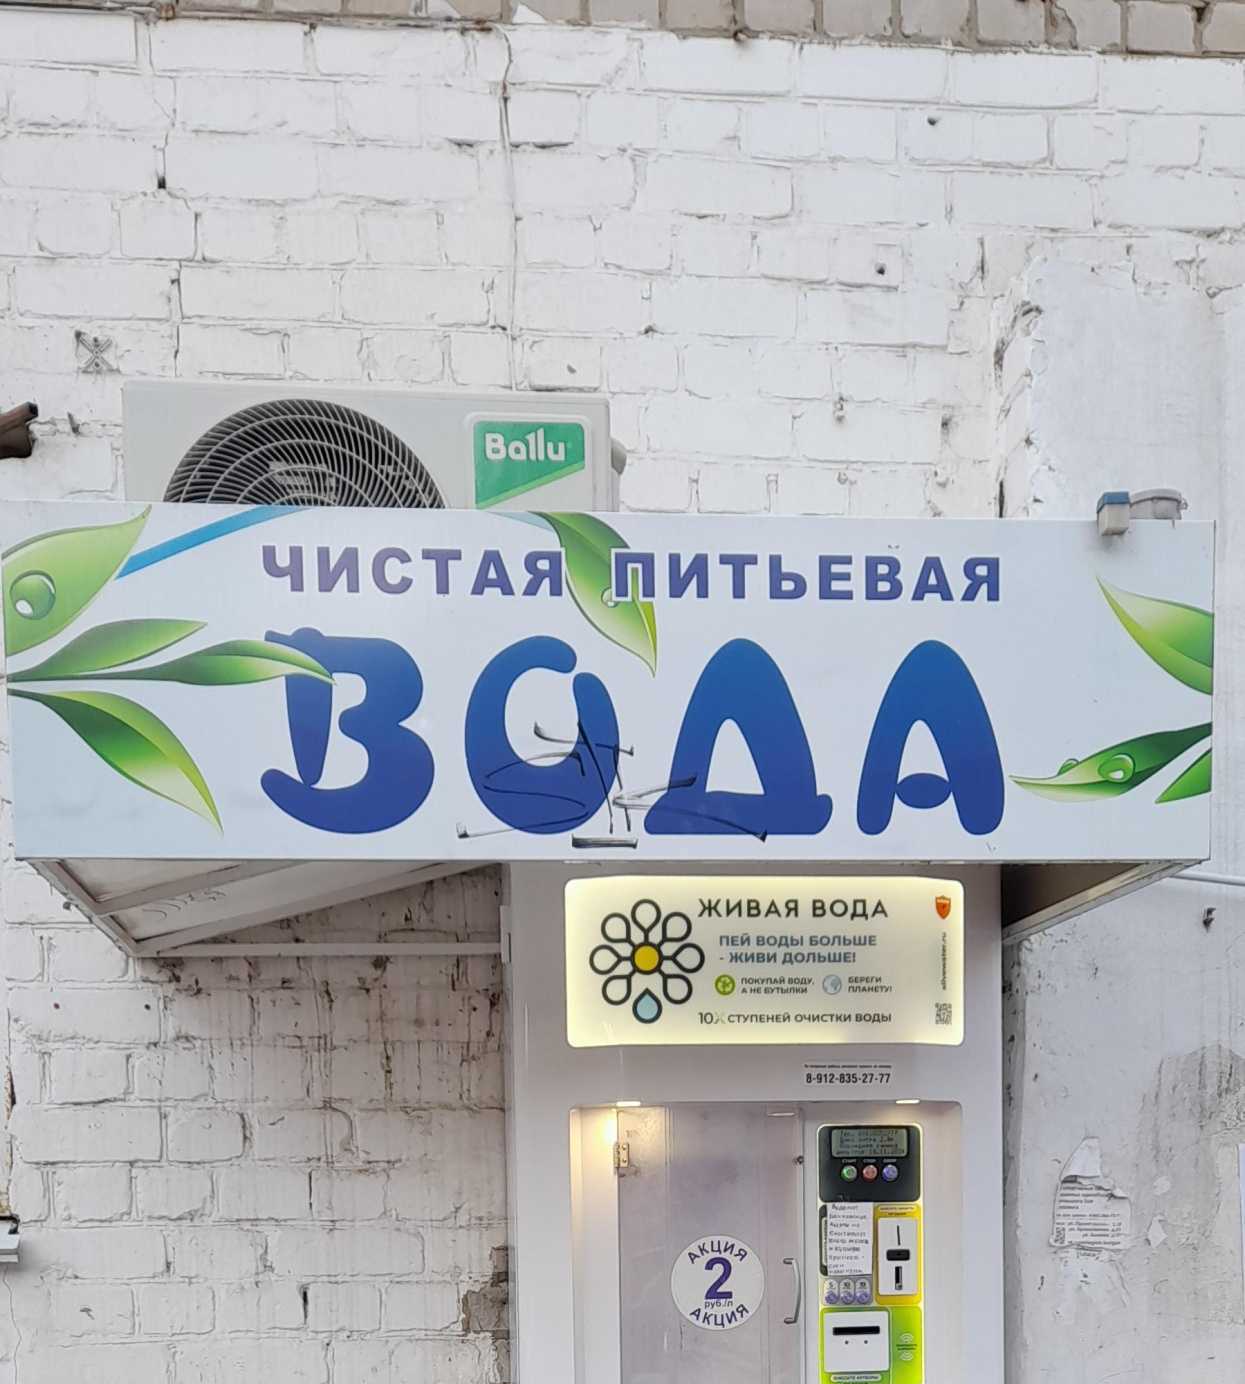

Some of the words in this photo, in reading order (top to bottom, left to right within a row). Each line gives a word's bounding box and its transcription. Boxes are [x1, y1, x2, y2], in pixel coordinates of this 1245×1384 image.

[485, 428, 566, 461] Ballu
[262, 545, 564, 597] ЧИСТАЯ
[614, 551, 1000, 602] ПИТЬЕВАЯ
[260, 626, 1005, 836] ВОДА
[698, 898, 800, 918] ЖИВАЯ
[812, 898, 888, 920] ВОДА
[719, 933, 751, 946] ПЕЙ
[756, 935, 804, 948] ВОДЫ
[809, 935, 877, 946] БОЛЬШЕ
[729, 952, 778, 963] ЖИВИ
[782, 952, 856, 965] ДОЛЬШЕ!
[741, 976, 786, 985] ПОКУПАЙ
[764, 987, 808, 995] БУТЫЛКИ
[727, 1012, 790, 1024] СТУПЕНЕЙ
[794, 1014, 851, 1023] ОЧИСТКИ
[855, 1013, 892, 1024] ВОДЫ
[806, 1073, 891, 1084] 8-912-835-27-77
[688, 1240, 748, 1264] АКЦИЯ
[704, 1257, 733, 1299] 2
[689, 1304, 749, 1328] АКЦИЯ
